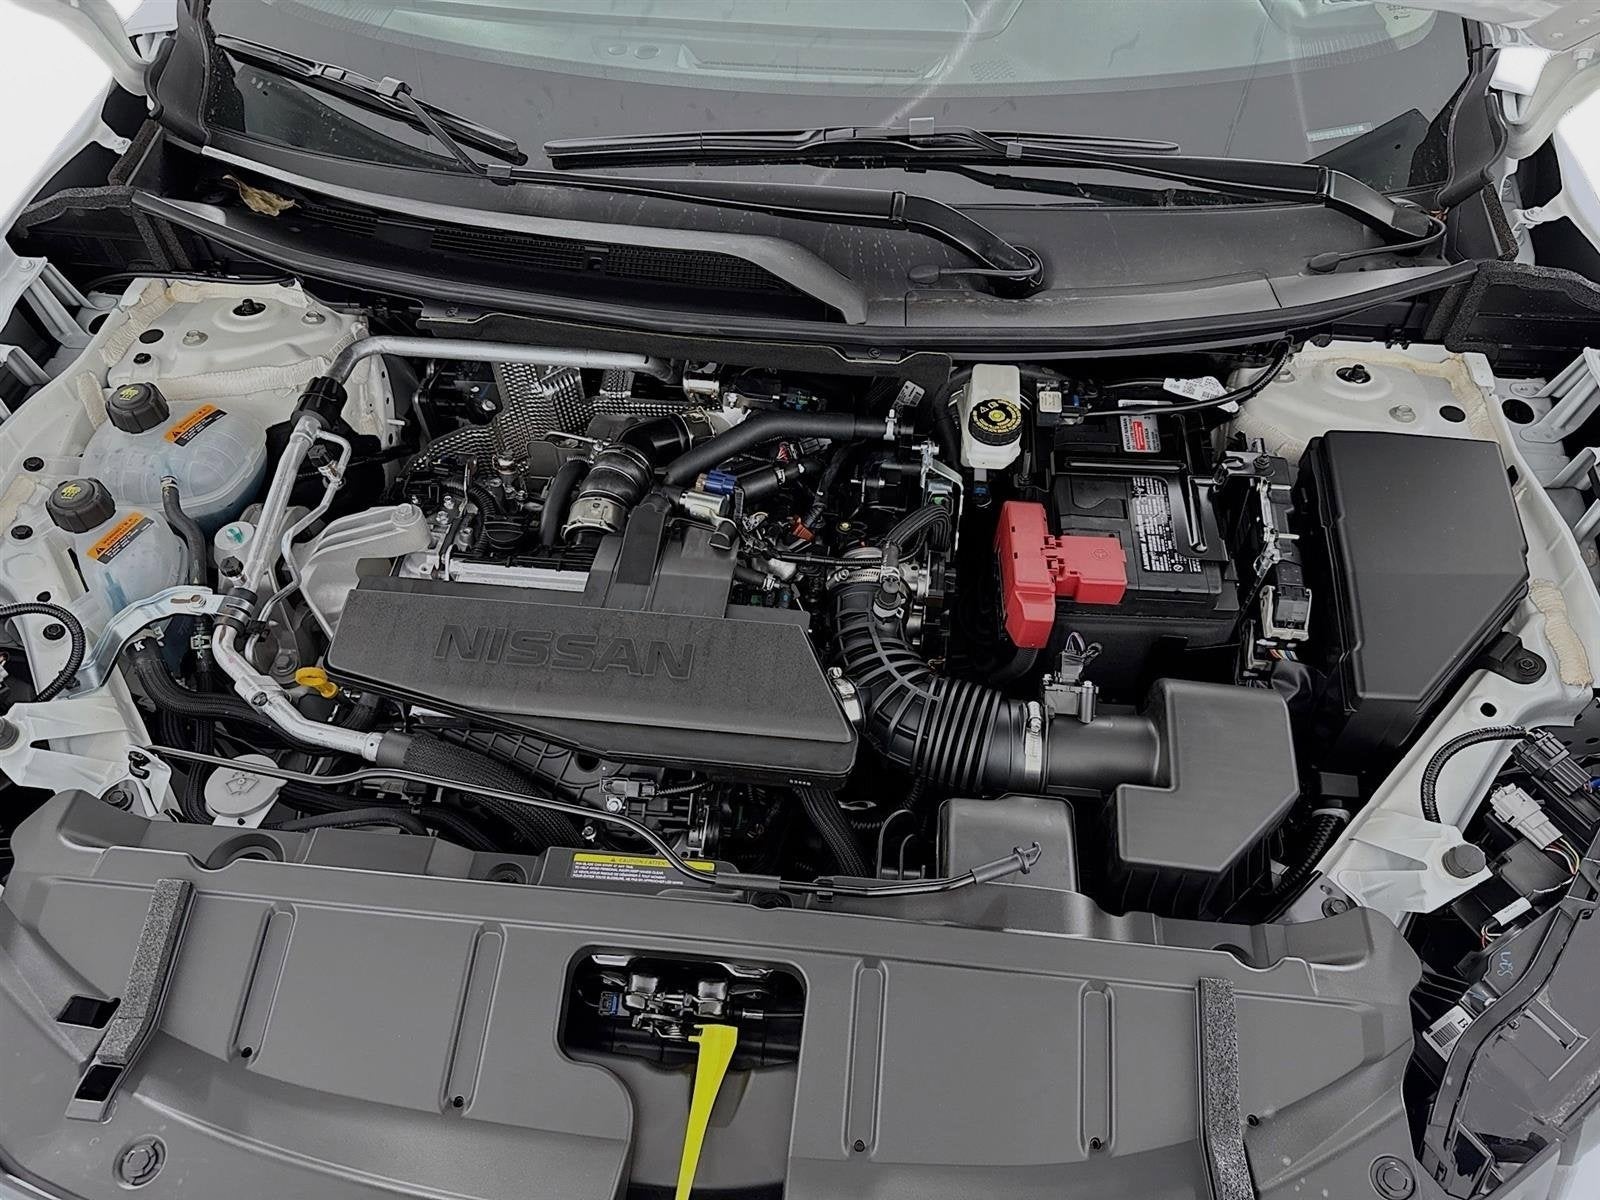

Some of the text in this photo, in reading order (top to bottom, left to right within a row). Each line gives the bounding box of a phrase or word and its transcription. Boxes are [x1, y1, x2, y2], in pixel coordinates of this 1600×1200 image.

[134, 641, 146, 652] K
[433, 624, 695, 679] NISSAN
[1458, 1018, 1469, 1028] B
